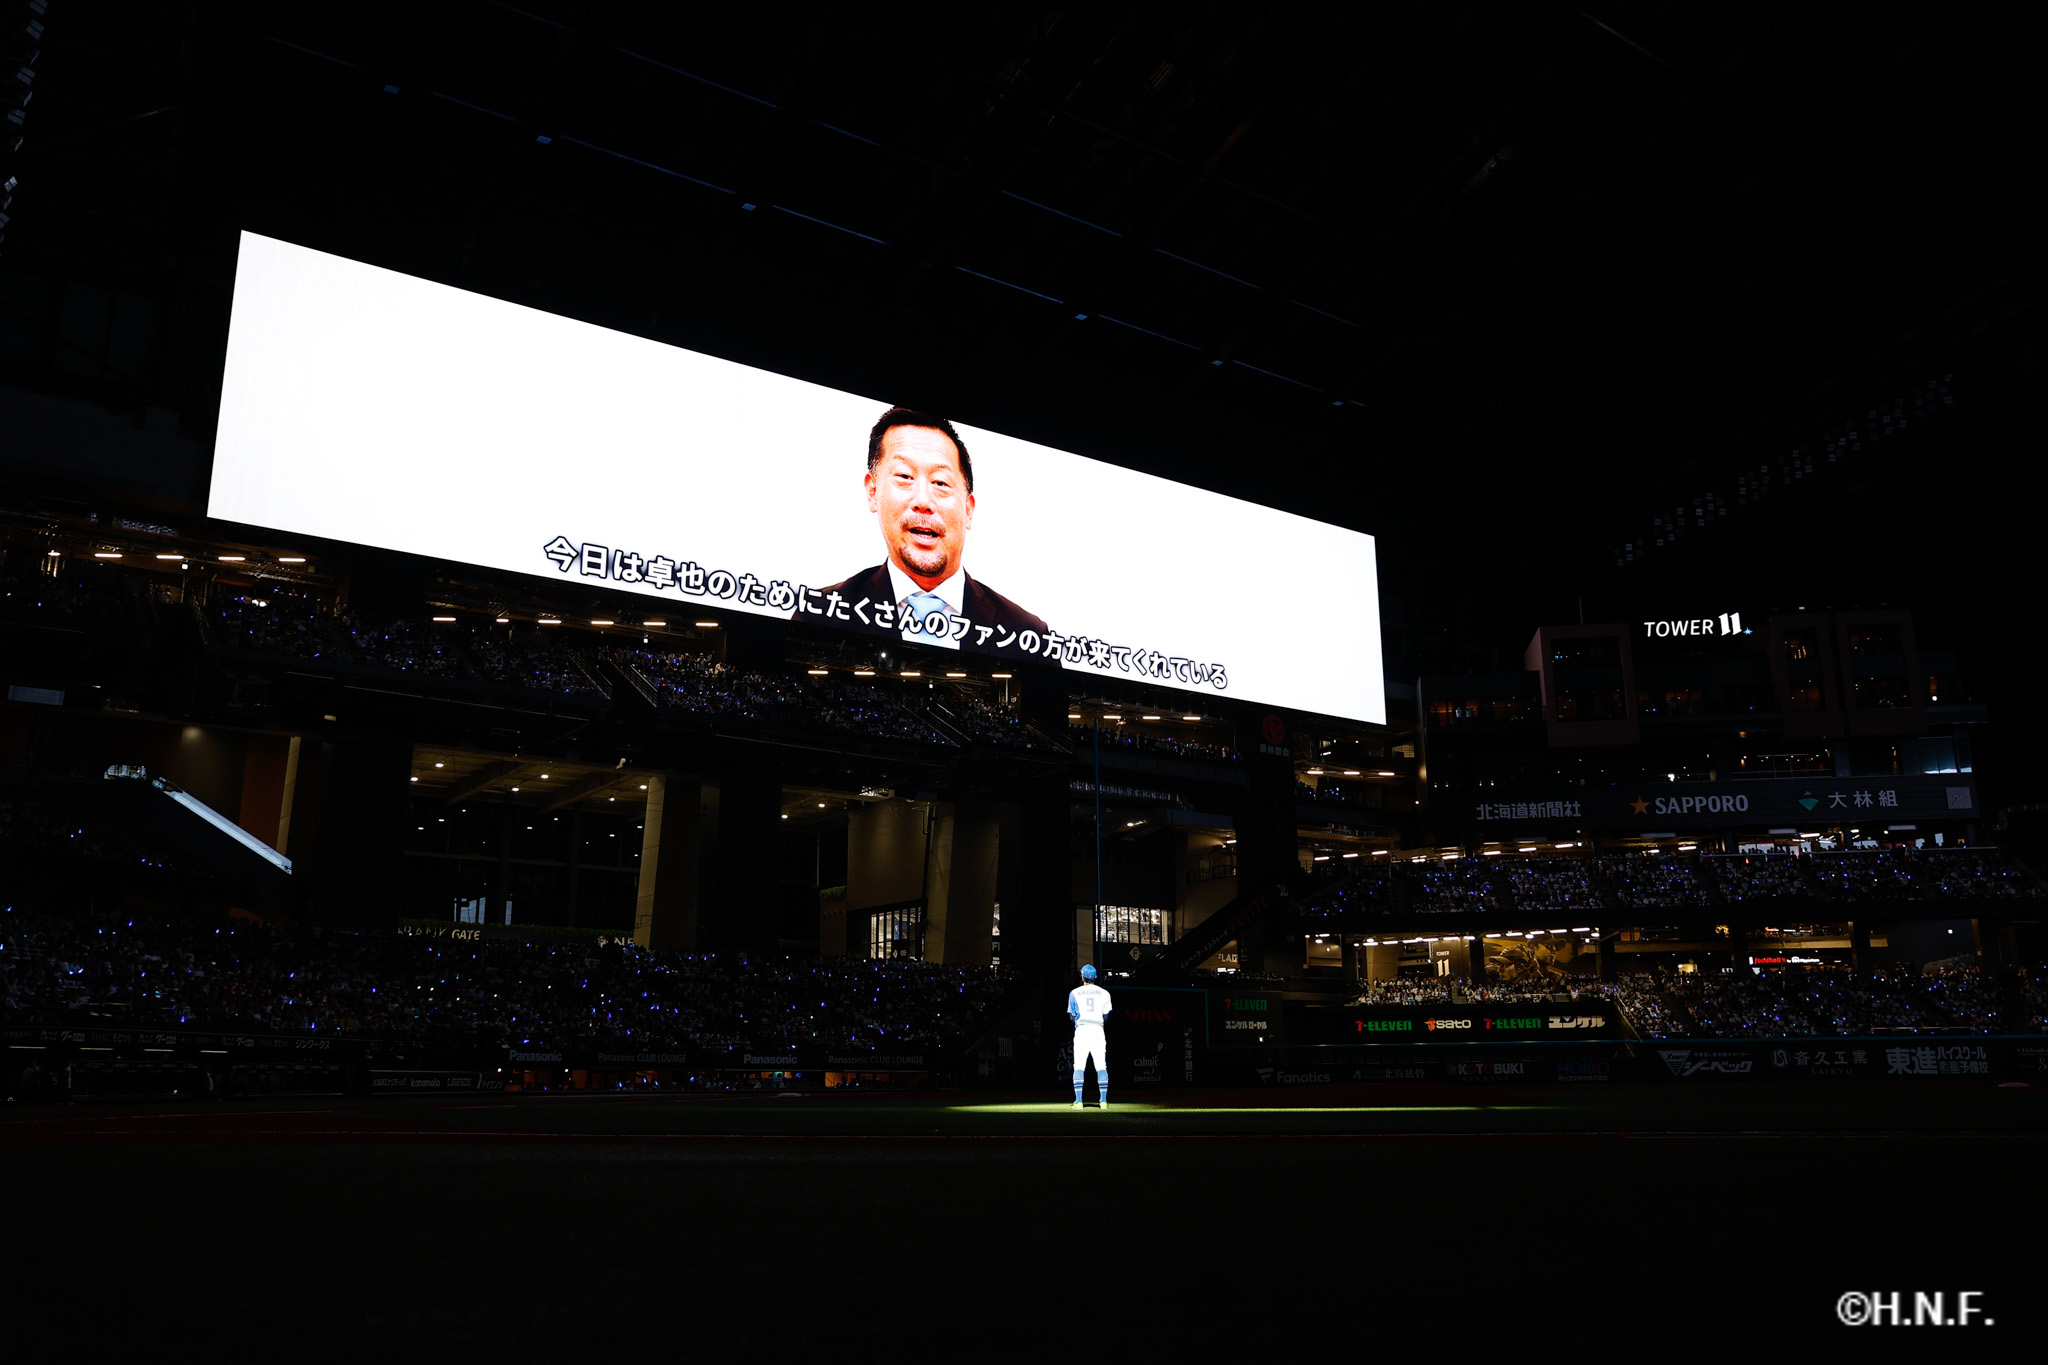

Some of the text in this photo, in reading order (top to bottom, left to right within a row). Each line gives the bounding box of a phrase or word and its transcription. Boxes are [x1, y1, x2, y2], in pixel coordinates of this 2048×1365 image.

[543, 535, 1229, 689] 今日は卓也のためにたくさんのファンの方が来てくれている
[1644, 611, 1743, 637] TOWER 11
[1655, 795, 1749, 815] SAPPORO
[1828, 790, 1898, 809] 大林組
[1476, 801, 1582, 821] 北海道新聞社
[1086, 997, 1095, 1013] 9
[509, 1050, 563, 1061] Panasonic
[598, 1053, 635, 1062] Panasonic
[743, 1054, 798, 1065] Panasonic
[828, 1055, 868, 1064] Panasonic
[1885, 1047, 1938, 1075] 東進
[1936, 1046, 1987, 1060] ハイスクール
[1276, 1071, 1331, 1084] Fanatics
